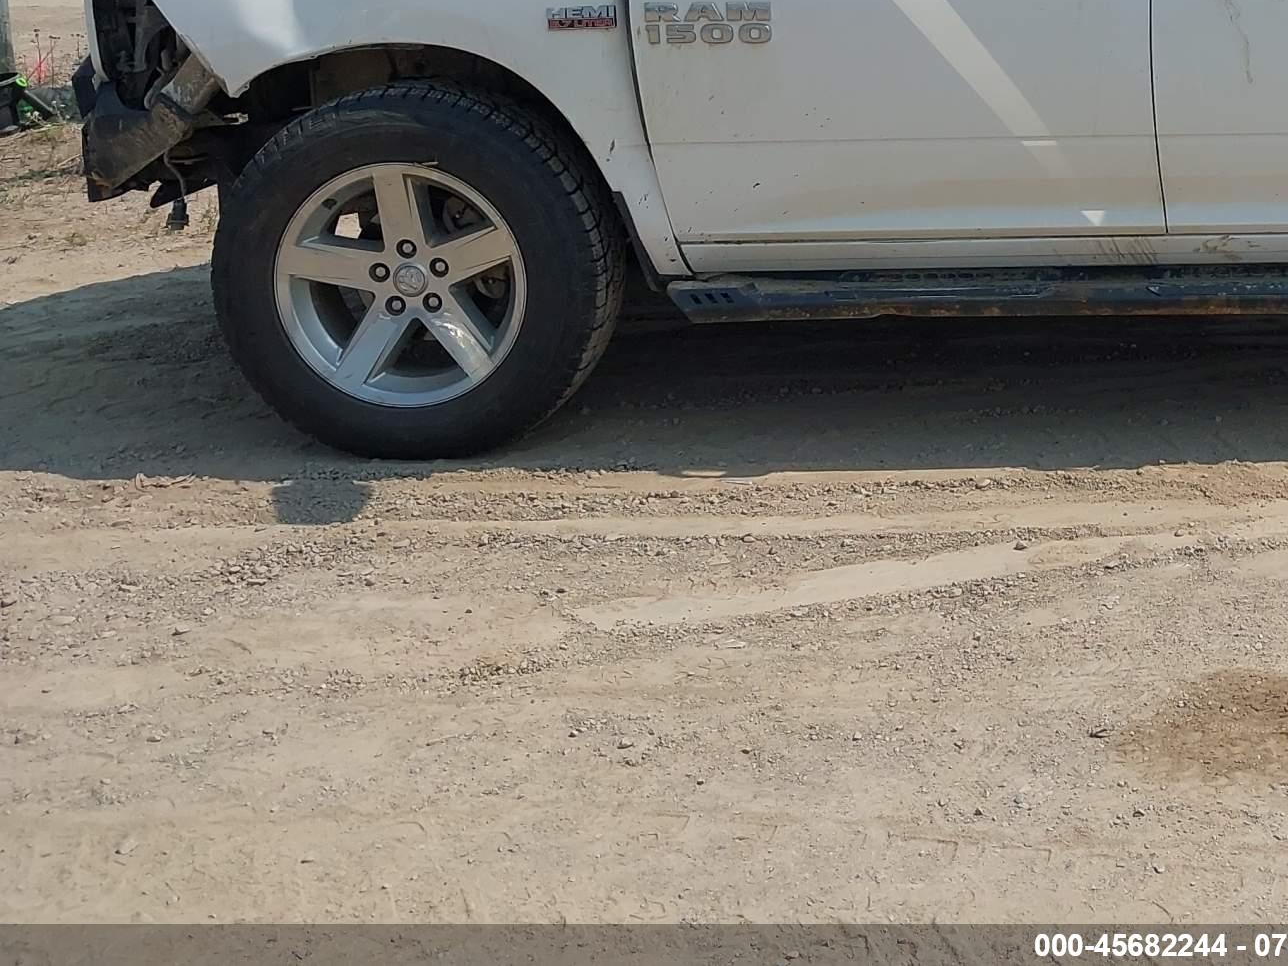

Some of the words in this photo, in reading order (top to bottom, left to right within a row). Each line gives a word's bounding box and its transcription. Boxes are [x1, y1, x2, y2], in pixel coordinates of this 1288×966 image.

[546, 5, 616, 19] HEMI
[644, 2, 771, 22] RAM
[645, 23, 772, 44] 1500
